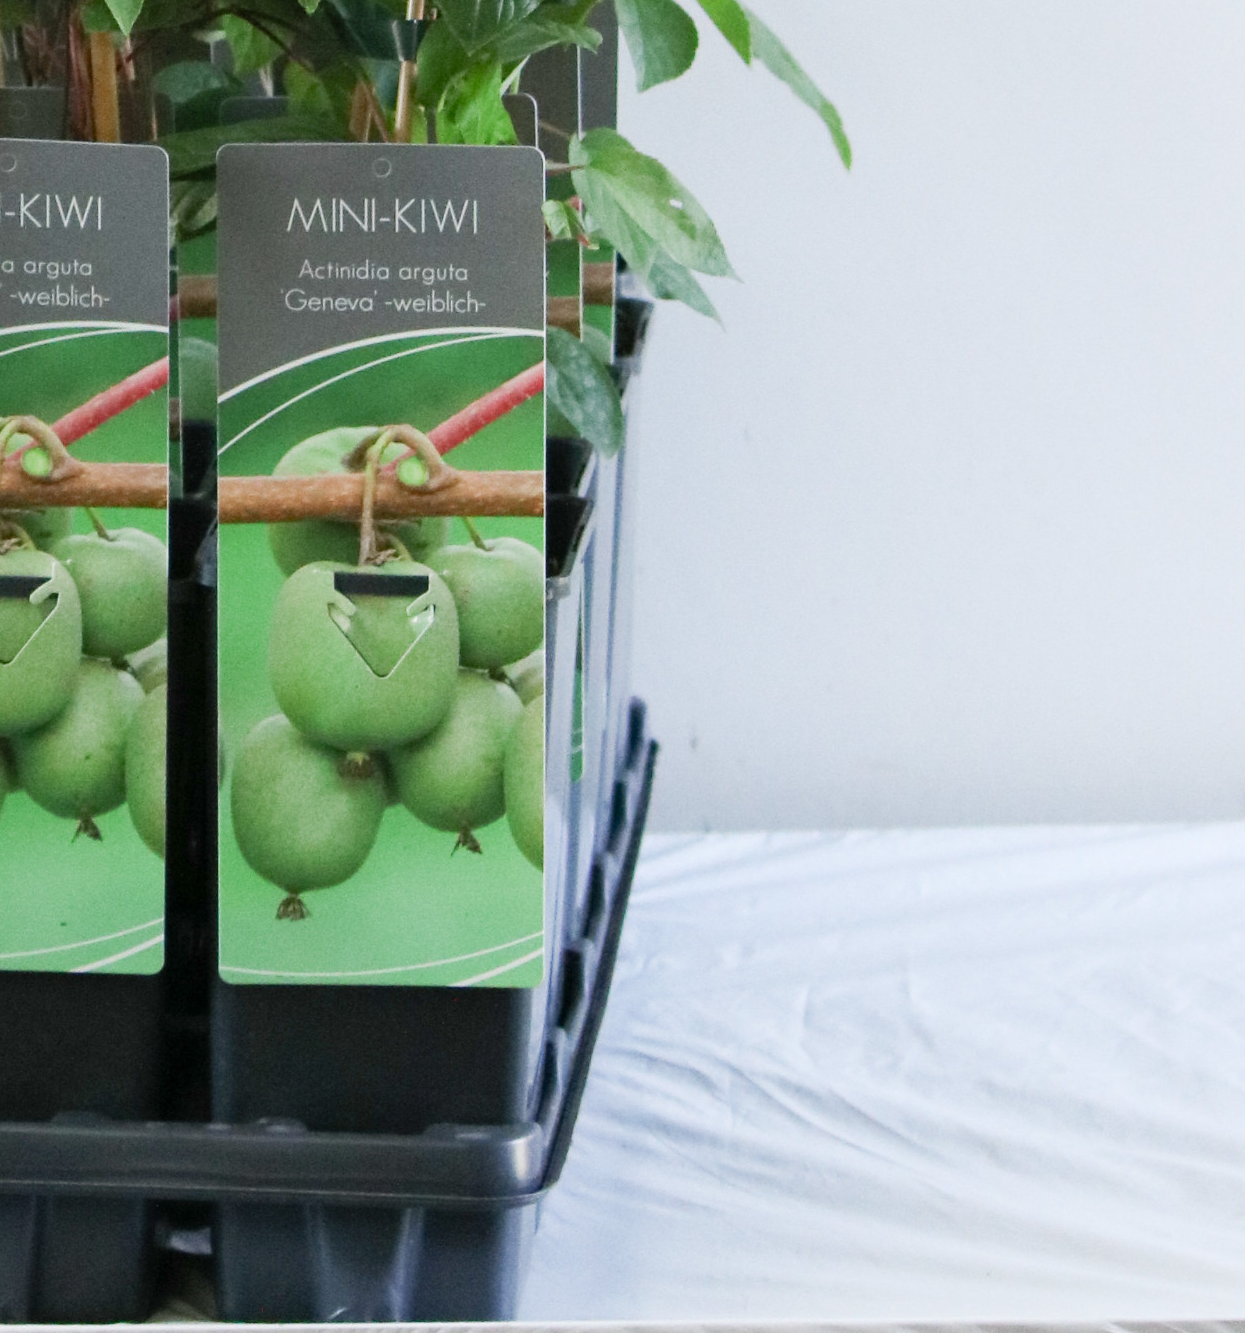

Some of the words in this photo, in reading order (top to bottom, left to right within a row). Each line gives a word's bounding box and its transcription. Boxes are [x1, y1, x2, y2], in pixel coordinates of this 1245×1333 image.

[287, 198, 477, 234] MINI-KIWI
[23, 259, 93, 280] arguta
[298, 259, 390, 280] Actinidia
[399, 264, 468, 285] arguta
[9, 284, 110, 308] -weiblich-
[385, 290, 486, 313] -weiblich-
